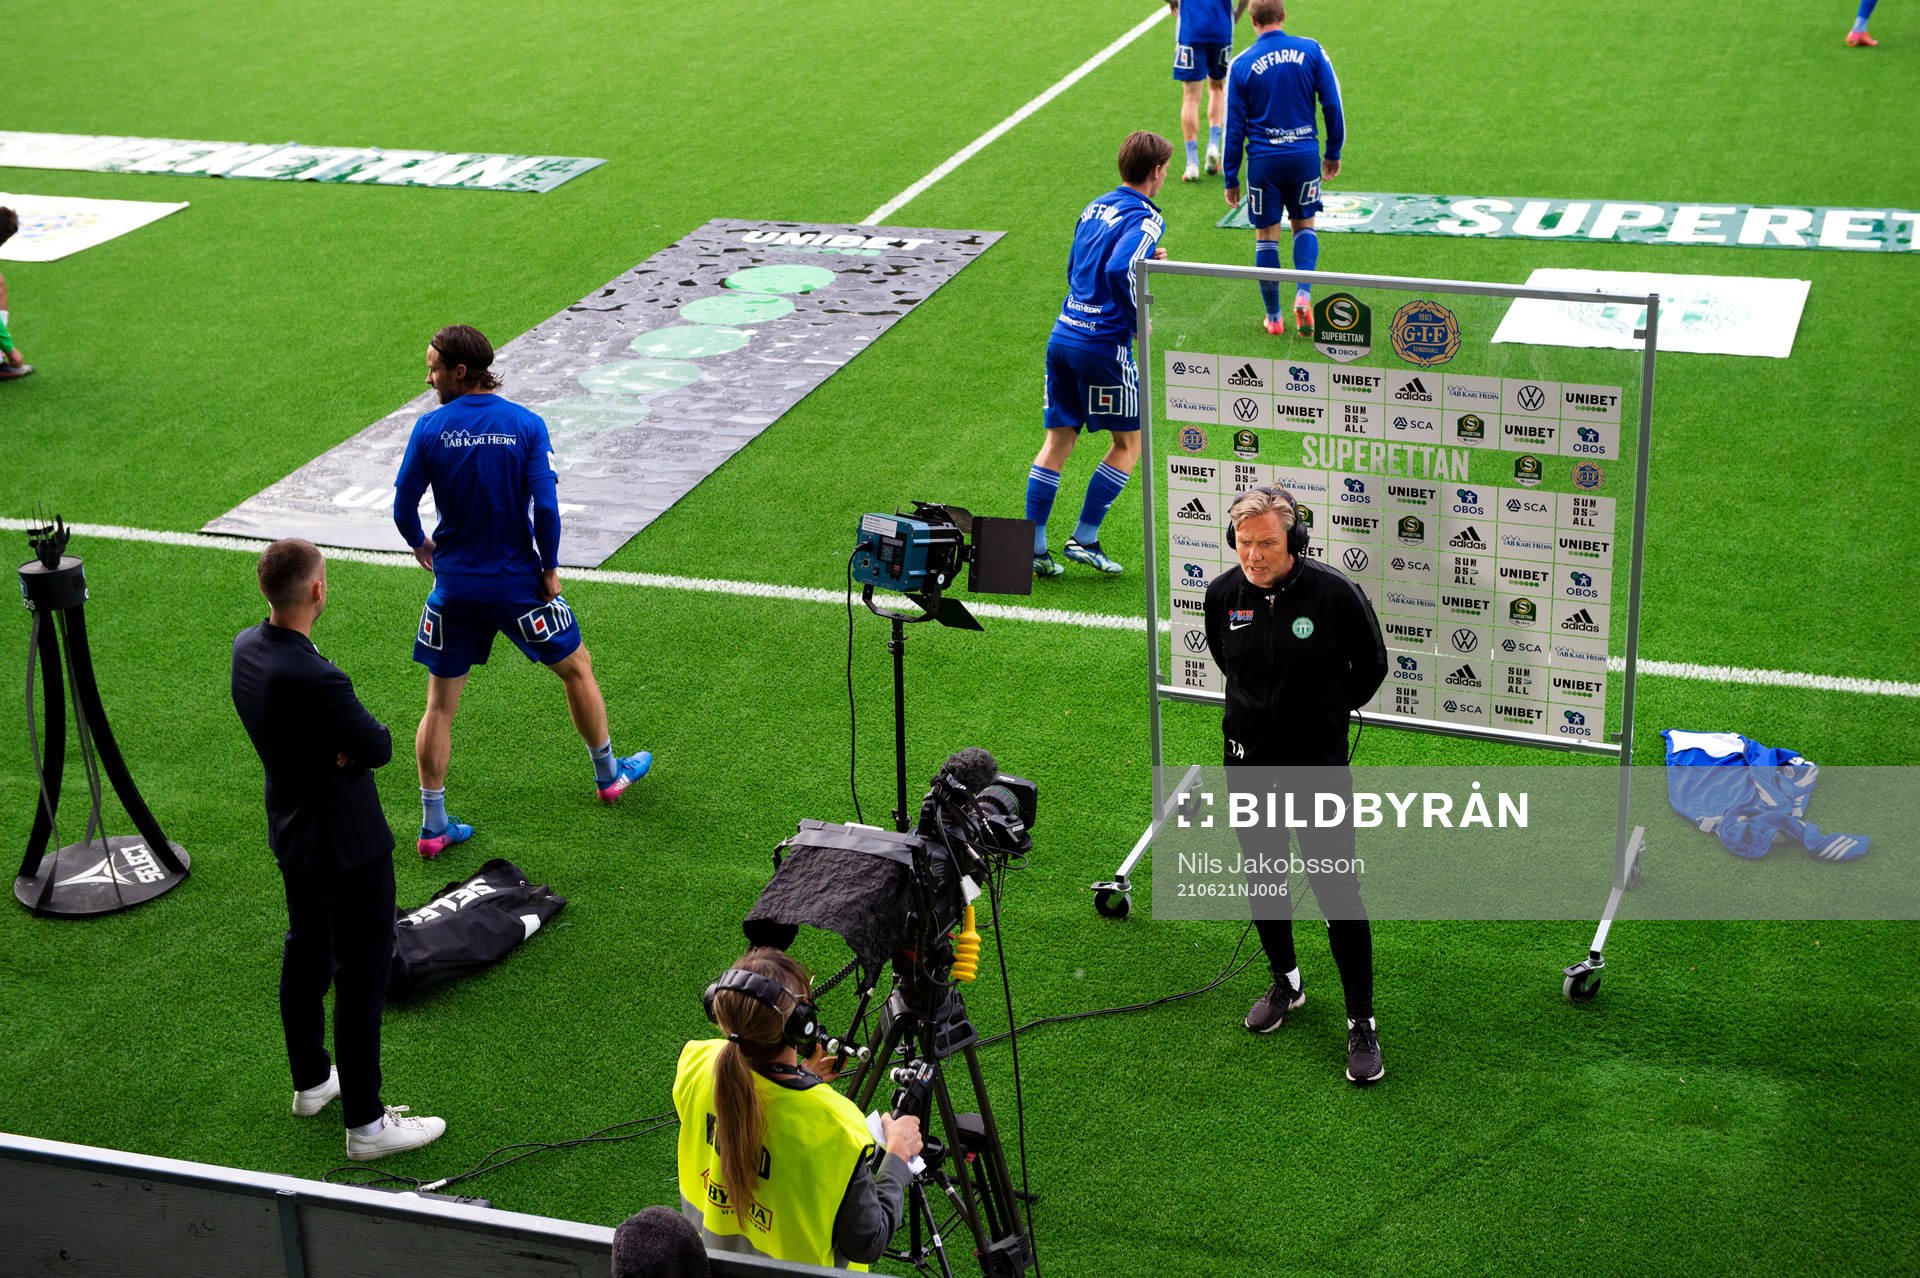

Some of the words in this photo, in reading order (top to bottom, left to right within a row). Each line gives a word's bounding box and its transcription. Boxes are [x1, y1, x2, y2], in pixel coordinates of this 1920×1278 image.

[1252, 48, 1305, 76] GIFFARNA
[20, 134, 543, 186] UPERETTAN
[741, 230, 935, 250] UNIBET
[1322, 331, 1364, 343] SUPERETTAN
[1188, 365, 1210, 375] SCA
[1228, 376, 1264, 387] adidas
[1332, 374, 1381, 387] UNIBET
[1286, 383, 1315, 393] OBOS
[1395, 390, 1432, 402] adidas
[1565, 392, 1617, 406] UNIBET
[1277, 404, 1324, 418] UNIBET
[1345, 405, 1366, 414] SUN
[1345, 424, 1366, 434] ALL
[1410, 421, 1433, 430] SCA
[1505, 425, 1555, 438] UNIBET
[450, 438, 462, 448] AB
[464, 437, 486, 447] KARL
[487, 436, 516, 446] HEDIN
[1573, 444, 1605, 454] OBOS
[1302, 435, 1469, 482] SUPERETTAN
[1171, 464, 1215, 477] UNIBET
[1235, 465, 1255, 474] SUN
[1388, 486, 1436, 500] UNIBET
[1341, 494, 1370, 503] OBOS
[1573, 498, 1597, 507] SUN
[1453, 505, 1484, 515] OBOS
[1524, 502, 1547, 512] SCA
[1177, 511, 1211, 520] adidas
[1332, 515, 1379, 528] UNIBET
[1573, 518, 1595, 527] ALL
[1450, 539, 1486, 550] adidas
[1559, 539, 1609, 552] UNIBET
[1300, 547, 1323, 557] BET
[1408, 561, 1430, 571] SCA
[1455, 557, 1477, 567] SUN
[1500, 568, 1549, 581] UNIBET
[1181, 578, 1209, 588] OBOS
[1455, 576, 1476, 585] ALL
[1566, 588, 1598, 598] OBOS
[1173, 599, 1205, 610] UNIB
[1442, 596, 1490, 610] UNIBET
[1386, 624, 1432, 638] UNIBET
[1561, 621, 1599, 633] adidas
[1519, 643, 1541, 653] SCA
[1185, 660, 1205, 670] SUN
[1394, 671, 1423, 681] OBOS
[1508, 667, 1530, 676] SUN
[1185, 678, 1204, 687] ALL
[1445, 676, 1482, 688] adidas
[1553, 678, 1602, 692] UNIBET
[1396, 687, 1417, 696] SUN
[1508, 686, 1529, 695] ALL
[1396, 706, 1416, 714] ALL
[1460, 704, 1482, 714] SCA
[1495, 705, 1543, 719] UNIBET
[1560, 726, 1591, 736] OBOS
[120, 844, 166, 883] SELECT
[397, 878, 496, 928] SELE
[708, 1184, 766, 1225] BYA
